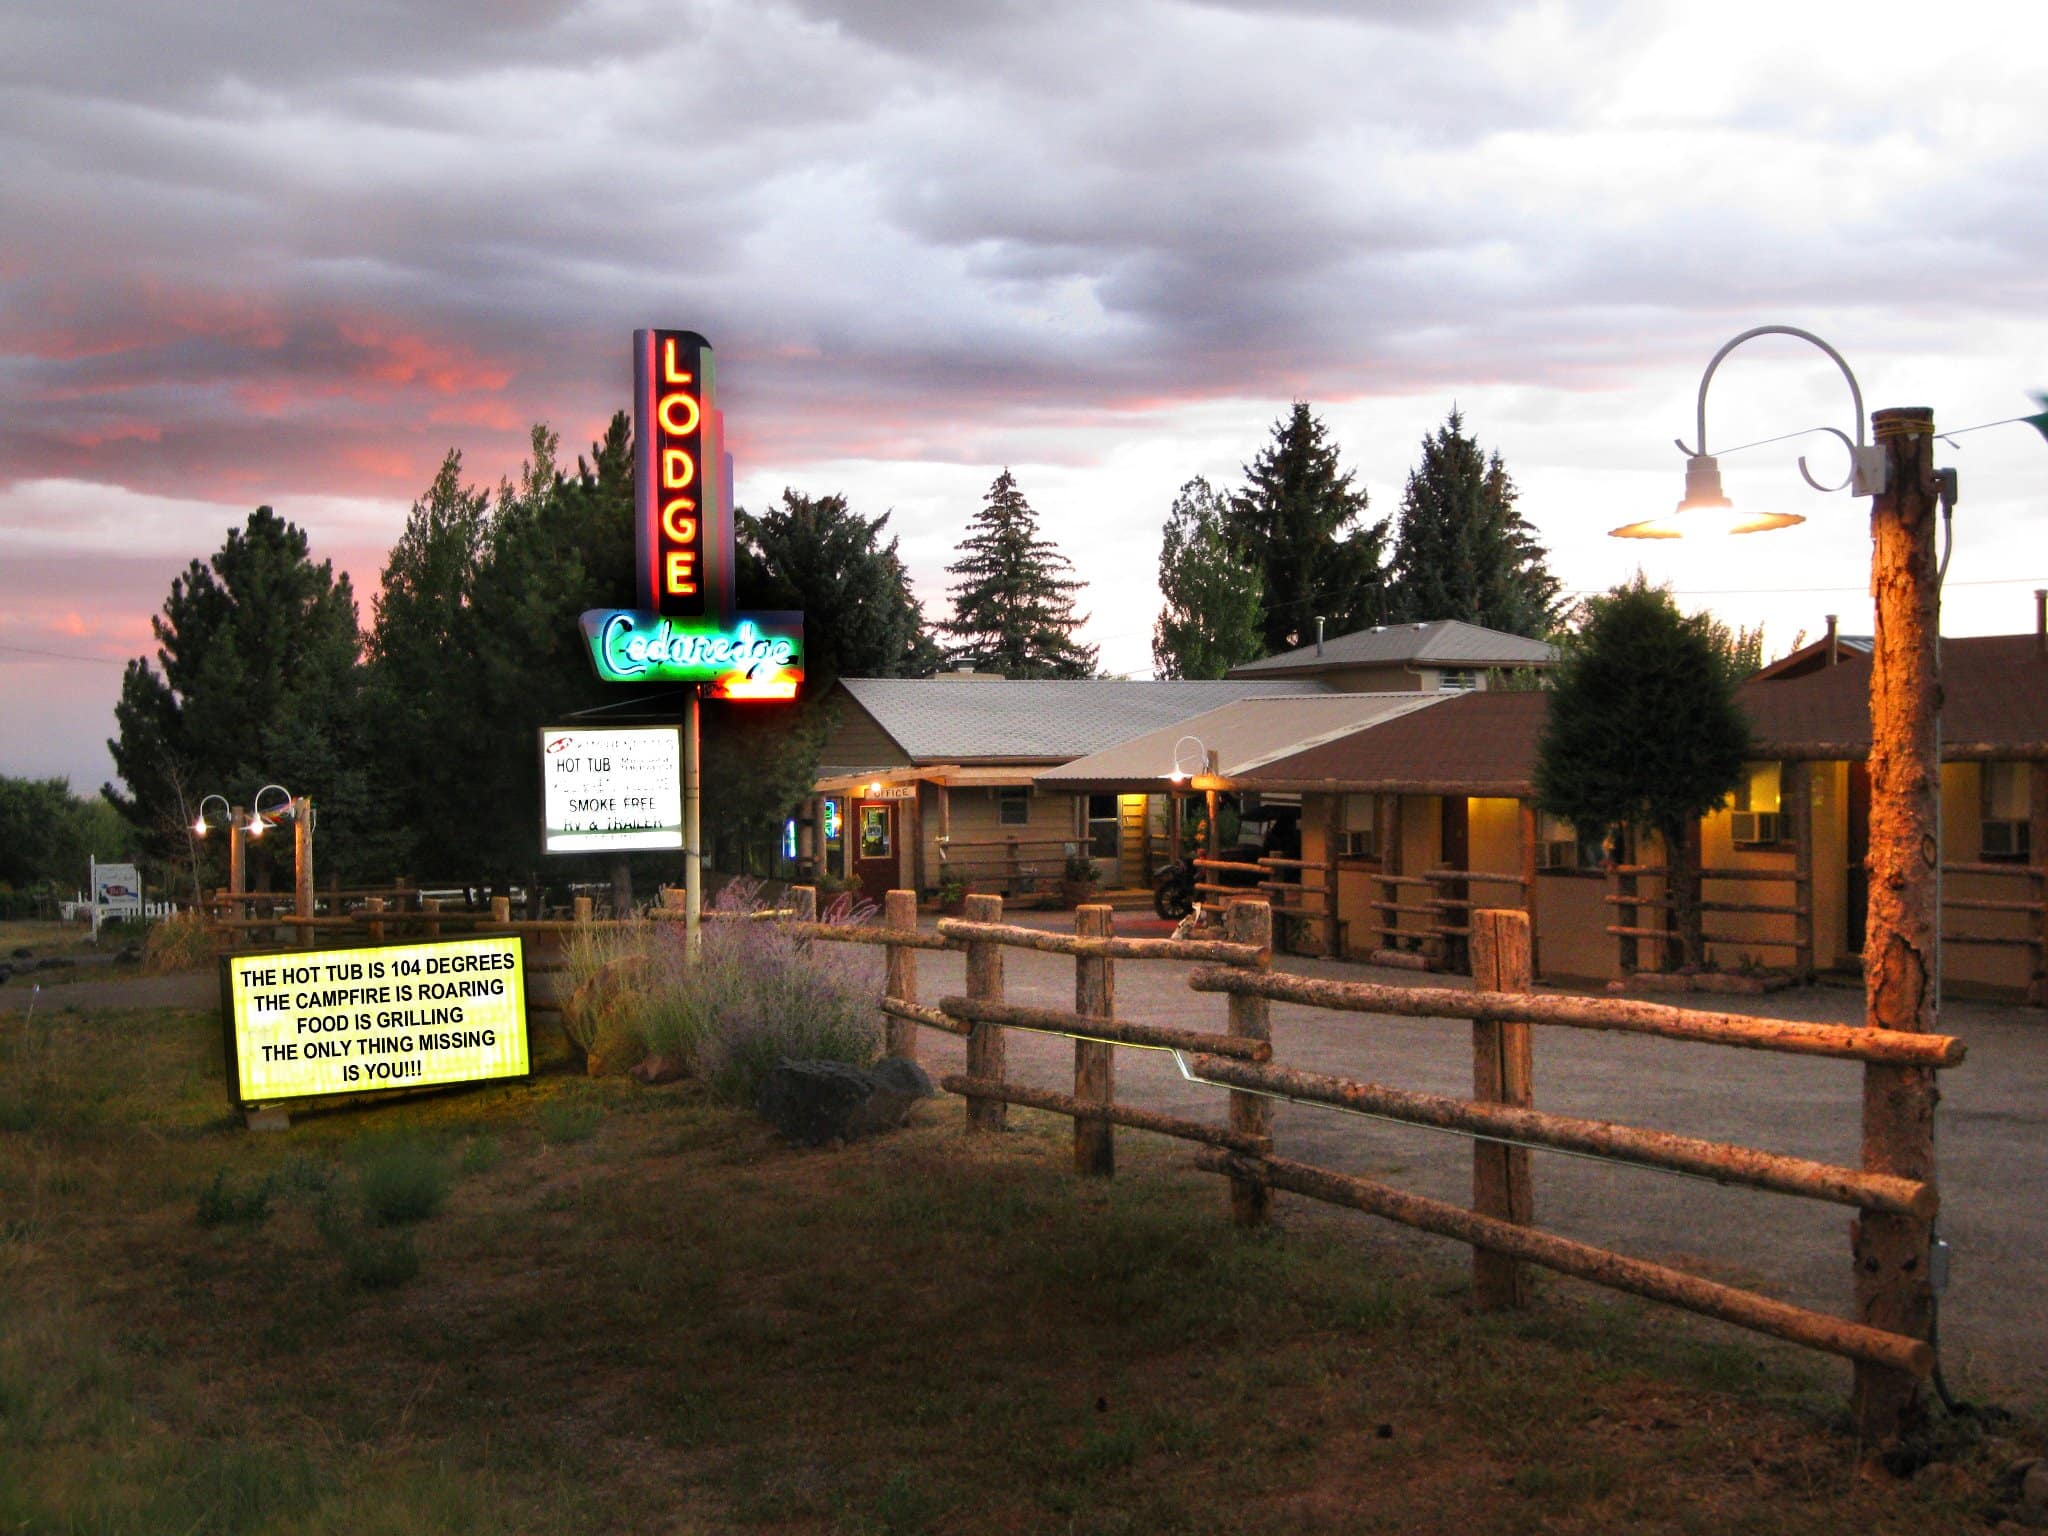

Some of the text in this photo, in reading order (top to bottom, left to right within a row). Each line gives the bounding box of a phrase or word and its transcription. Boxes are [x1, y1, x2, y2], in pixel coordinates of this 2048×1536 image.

[658, 338, 700, 593] LODGE
[602, 613, 798, 681] Cedaredge
[557, 758, 581, 772] HOT
[588, 757, 611, 772] TUB
[569, 798, 617, 812] SMOKE
[240, 953, 515, 988] THE HOT TUB IS 104 DEGREES
[254, 978, 504, 1012] THE CAMPFIRE IS ROARING
[297, 1006, 464, 1034] FOOD IS GRILLING
[262, 1029, 496, 1062] THE ONLY THING MISSING
[343, 1060, 422, 1082] IS YOU!!!
